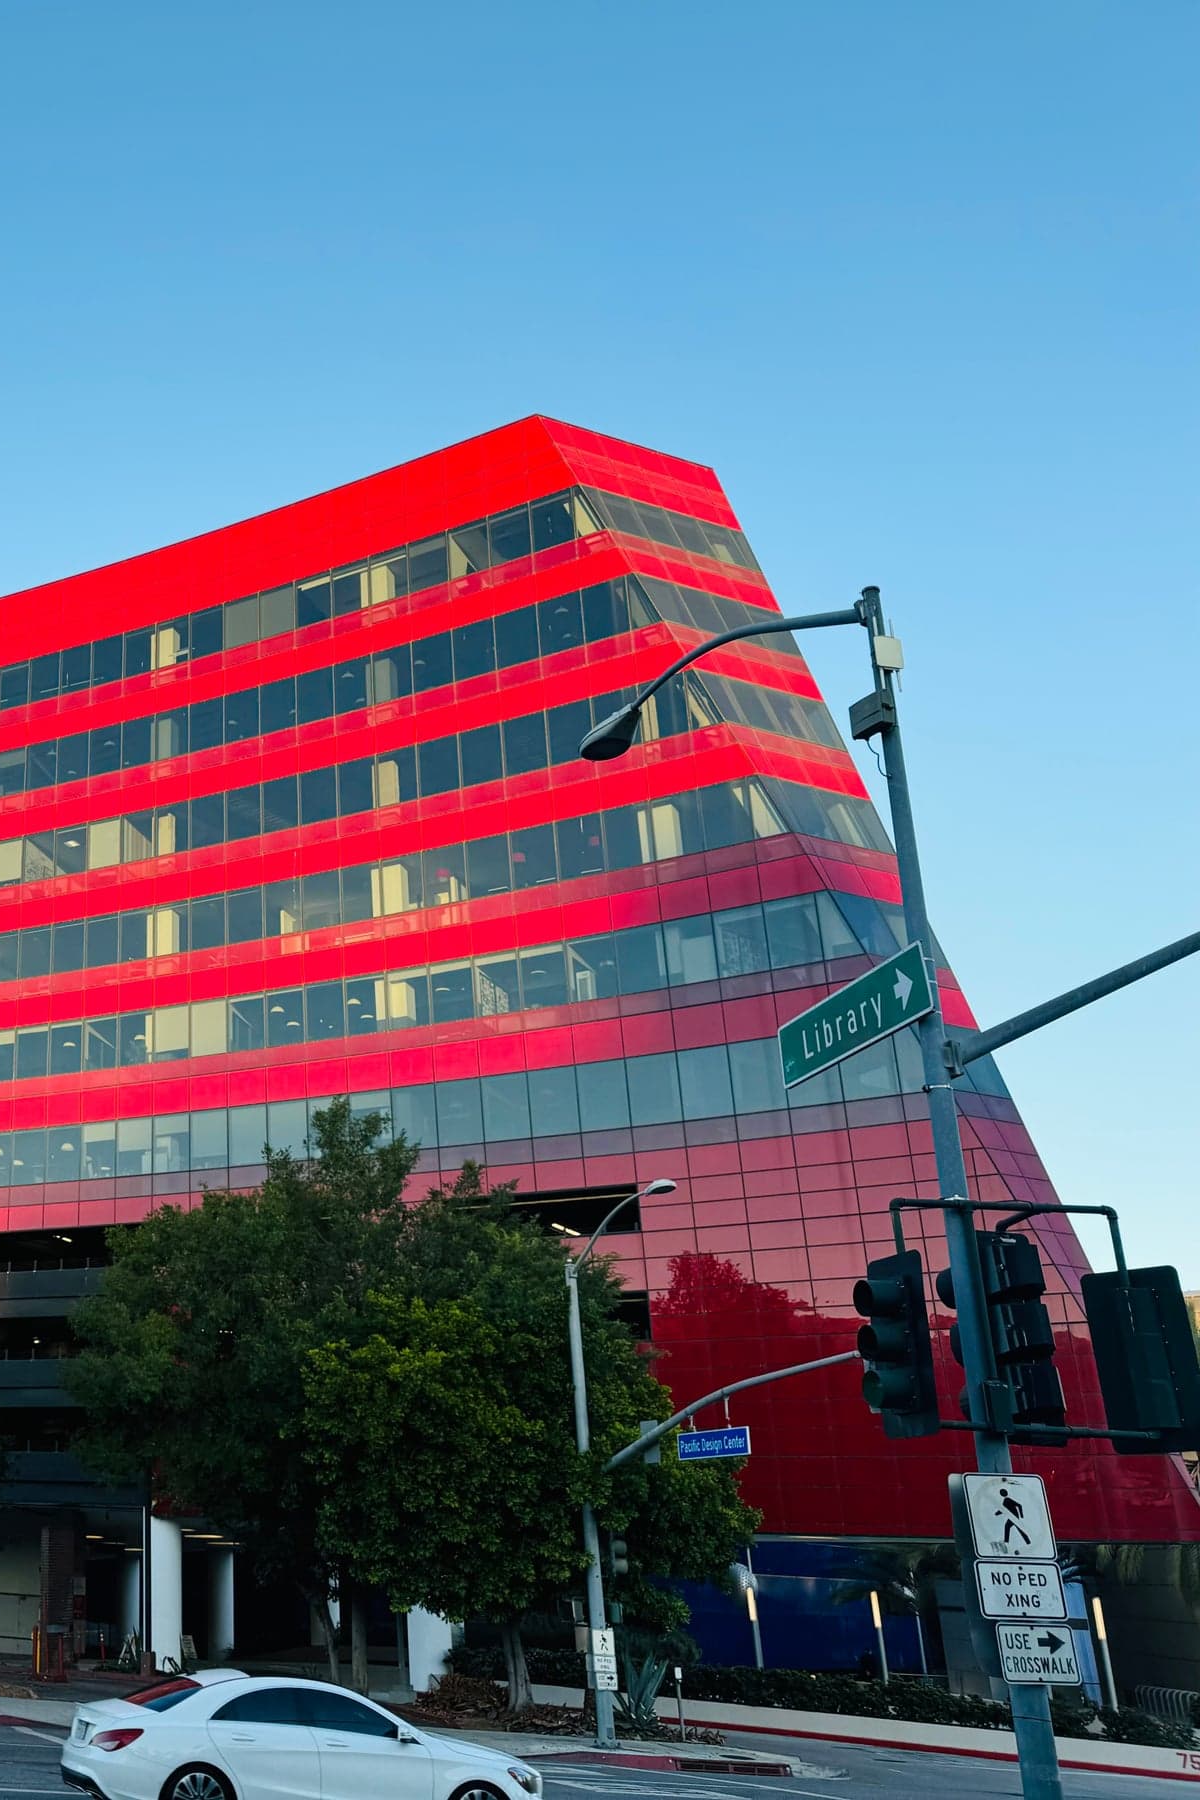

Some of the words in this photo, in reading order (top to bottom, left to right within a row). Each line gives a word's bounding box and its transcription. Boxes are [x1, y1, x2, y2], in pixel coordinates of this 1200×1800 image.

[802, 993, 882, 1060] Library
[680, 1439, 700, 1454] Pacific
[701, 1437, 722, 1453] Design
[723, 1435, 745, 1449] Center
[990, 1572, 1012, 1586] NO
[1017, 1573, 1047, 1587] PED
[1005, 1593, 1041, 1608] XING
[1004, 1633, 1032, 1650] USE
[1005, 1656, 1076, 1675] CROSSWALK
